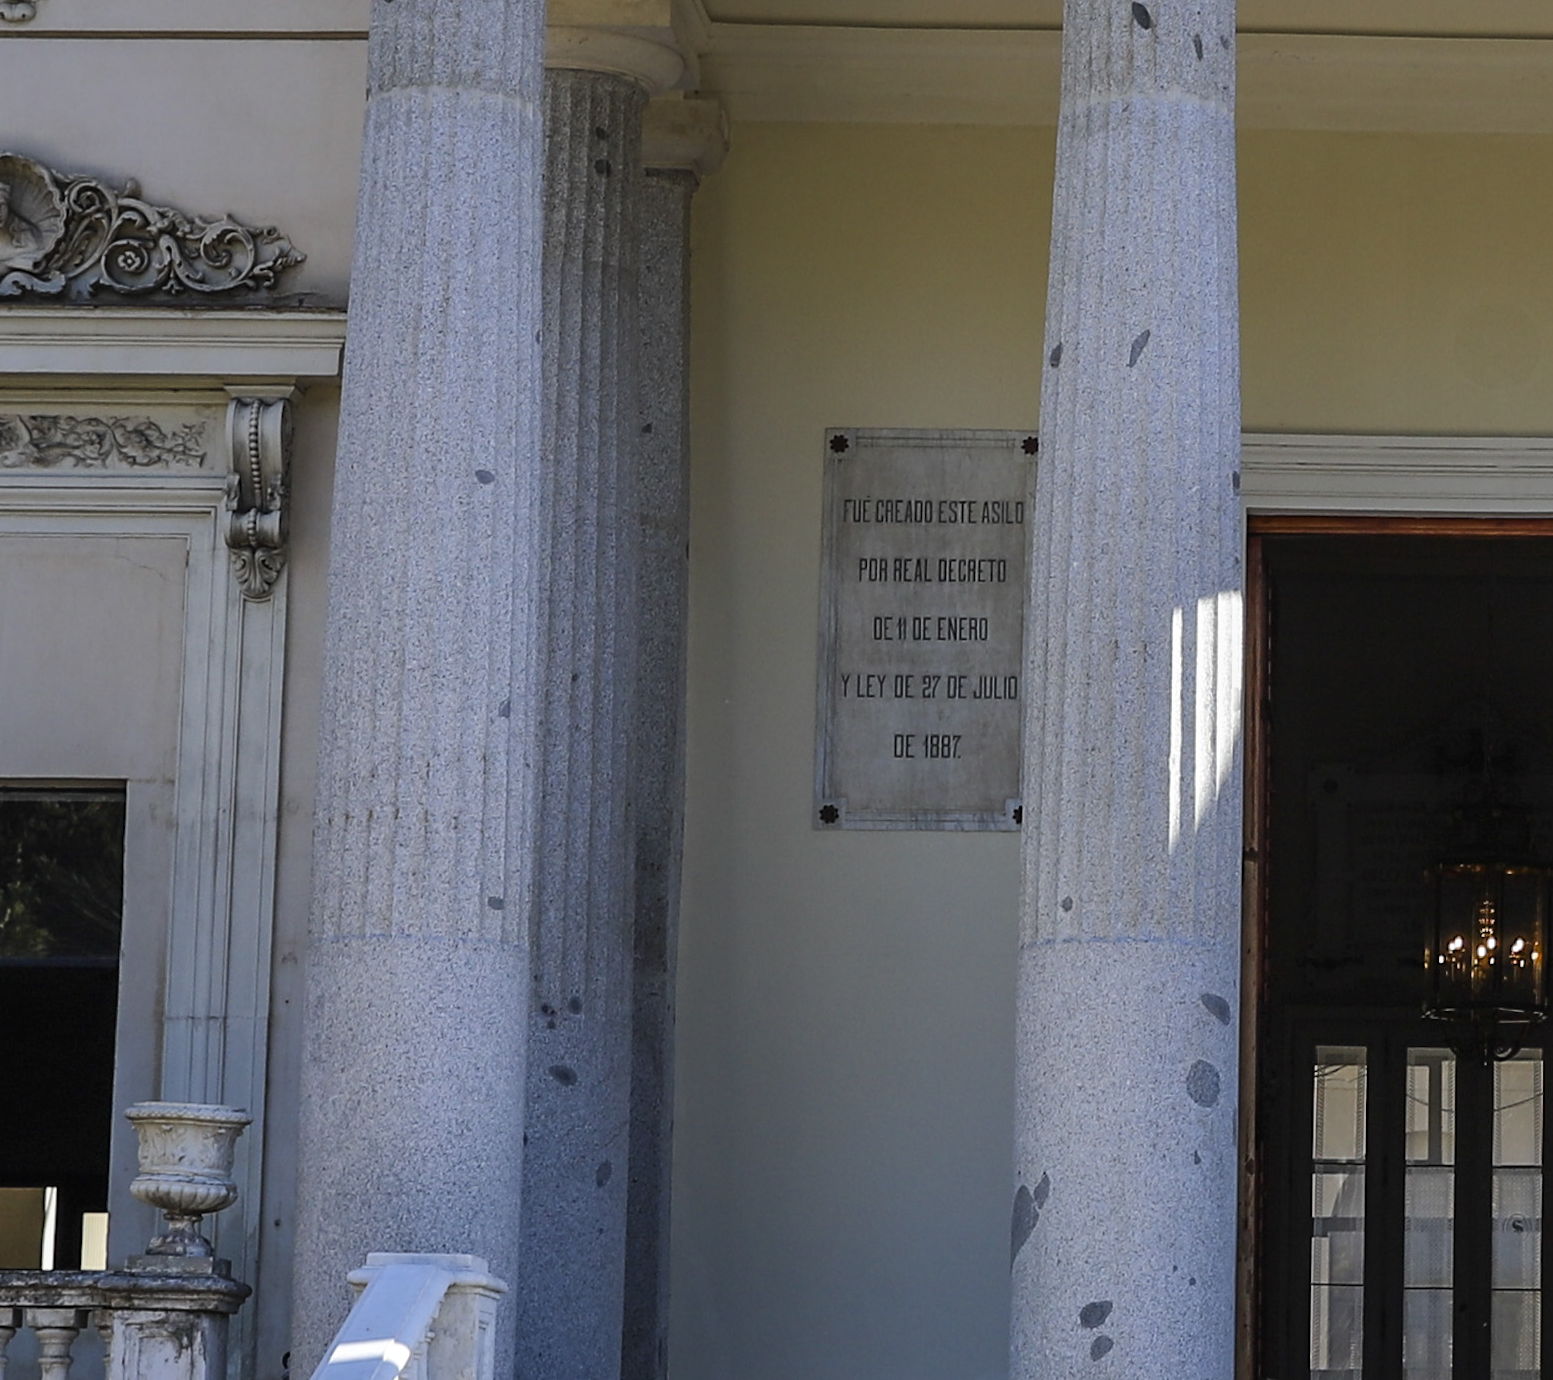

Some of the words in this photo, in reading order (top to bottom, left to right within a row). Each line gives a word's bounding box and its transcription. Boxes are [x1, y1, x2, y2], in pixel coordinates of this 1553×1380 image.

[875, 499, 933, 524] CREADO
[938, 500, 977, 524] ESTE
[981, 501, 1024, 525] ASILO
[859, 557, 888, 582] POR
[893, 557, 932, 582] REAL
[938, 558, 1007, 583] DECRETO
[873, 616, 894, 641] DE
[896, 616, 907, 641] 11
[912, 616, 932, 641] DE
[936, 616, 989, 641] ENERO
[841, 674, 852, 699] Y
[856, 674, 885, 699] LEY
[894, 674, 914, 699] DE
[921, 674, 941, 699] 27
[946, 675, 967, 700] DE
[973, 675, 1018, 700] JULIO
[893, 734, 915, 759] DE
